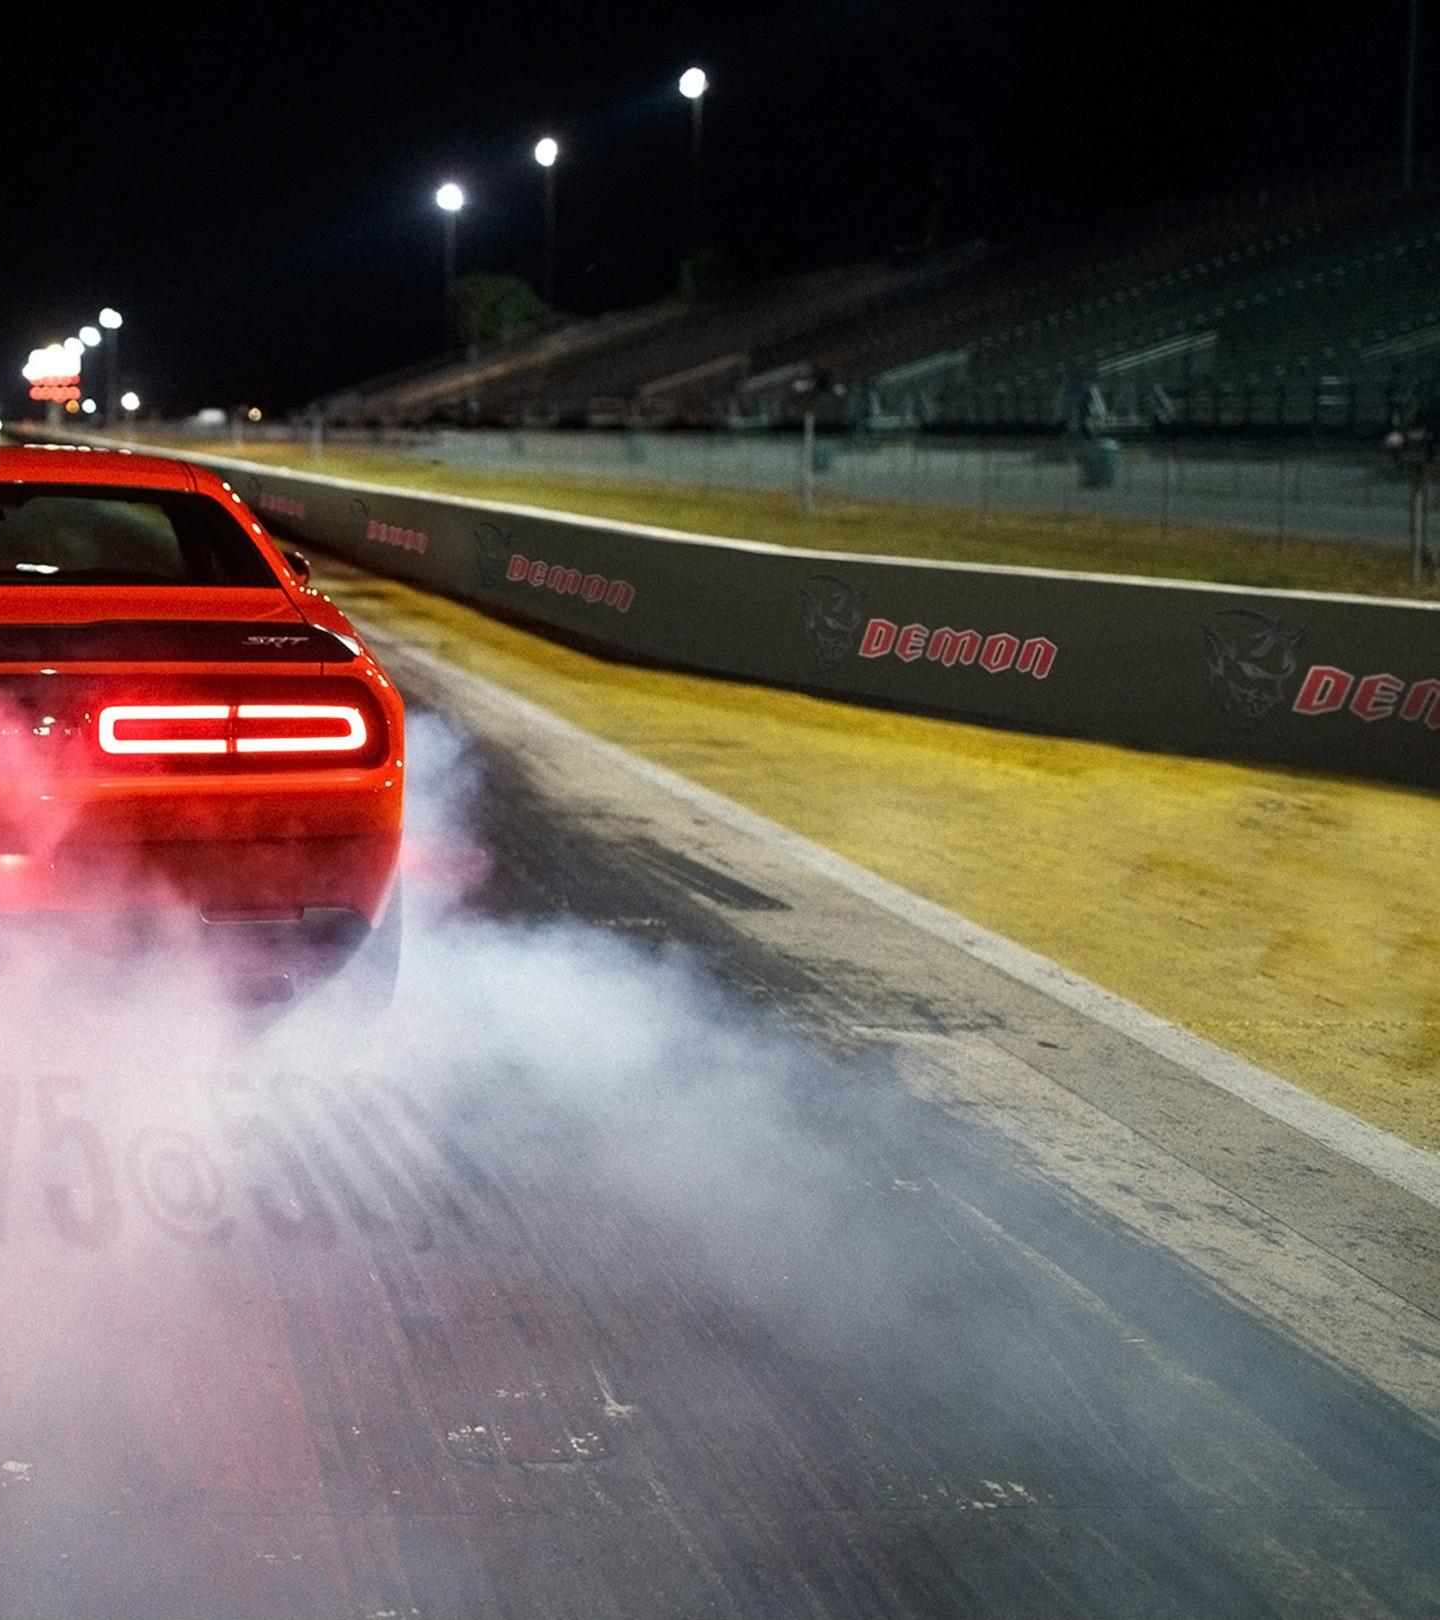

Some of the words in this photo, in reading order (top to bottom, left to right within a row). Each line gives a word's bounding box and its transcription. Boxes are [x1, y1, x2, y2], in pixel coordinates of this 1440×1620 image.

[506, 554, 636, 613] DEMON
[242, 636, 310, 649] SRT
[858, 618, 1059, 680] DEMON
